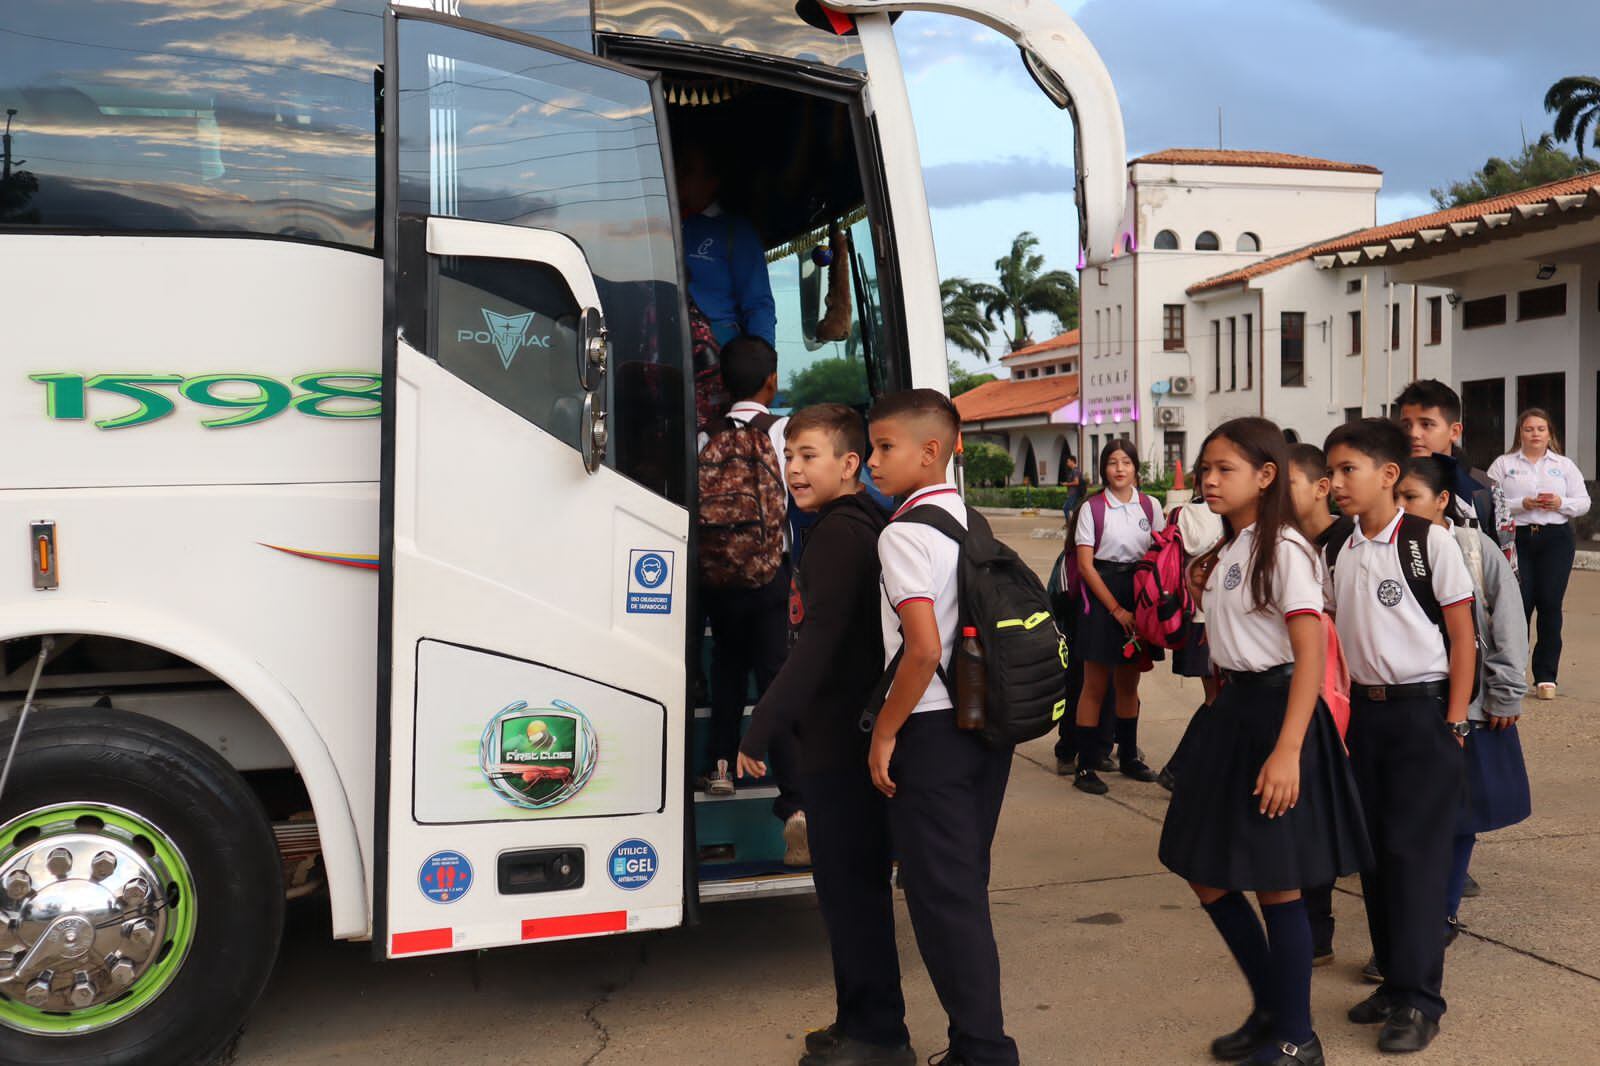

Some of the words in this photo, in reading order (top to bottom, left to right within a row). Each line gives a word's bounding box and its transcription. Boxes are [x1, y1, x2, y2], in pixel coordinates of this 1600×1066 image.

[28, 371, 382, 430] 1598
[617, 846, 649, 856] UTILICE
[626, 858, 654, 873] GEL
